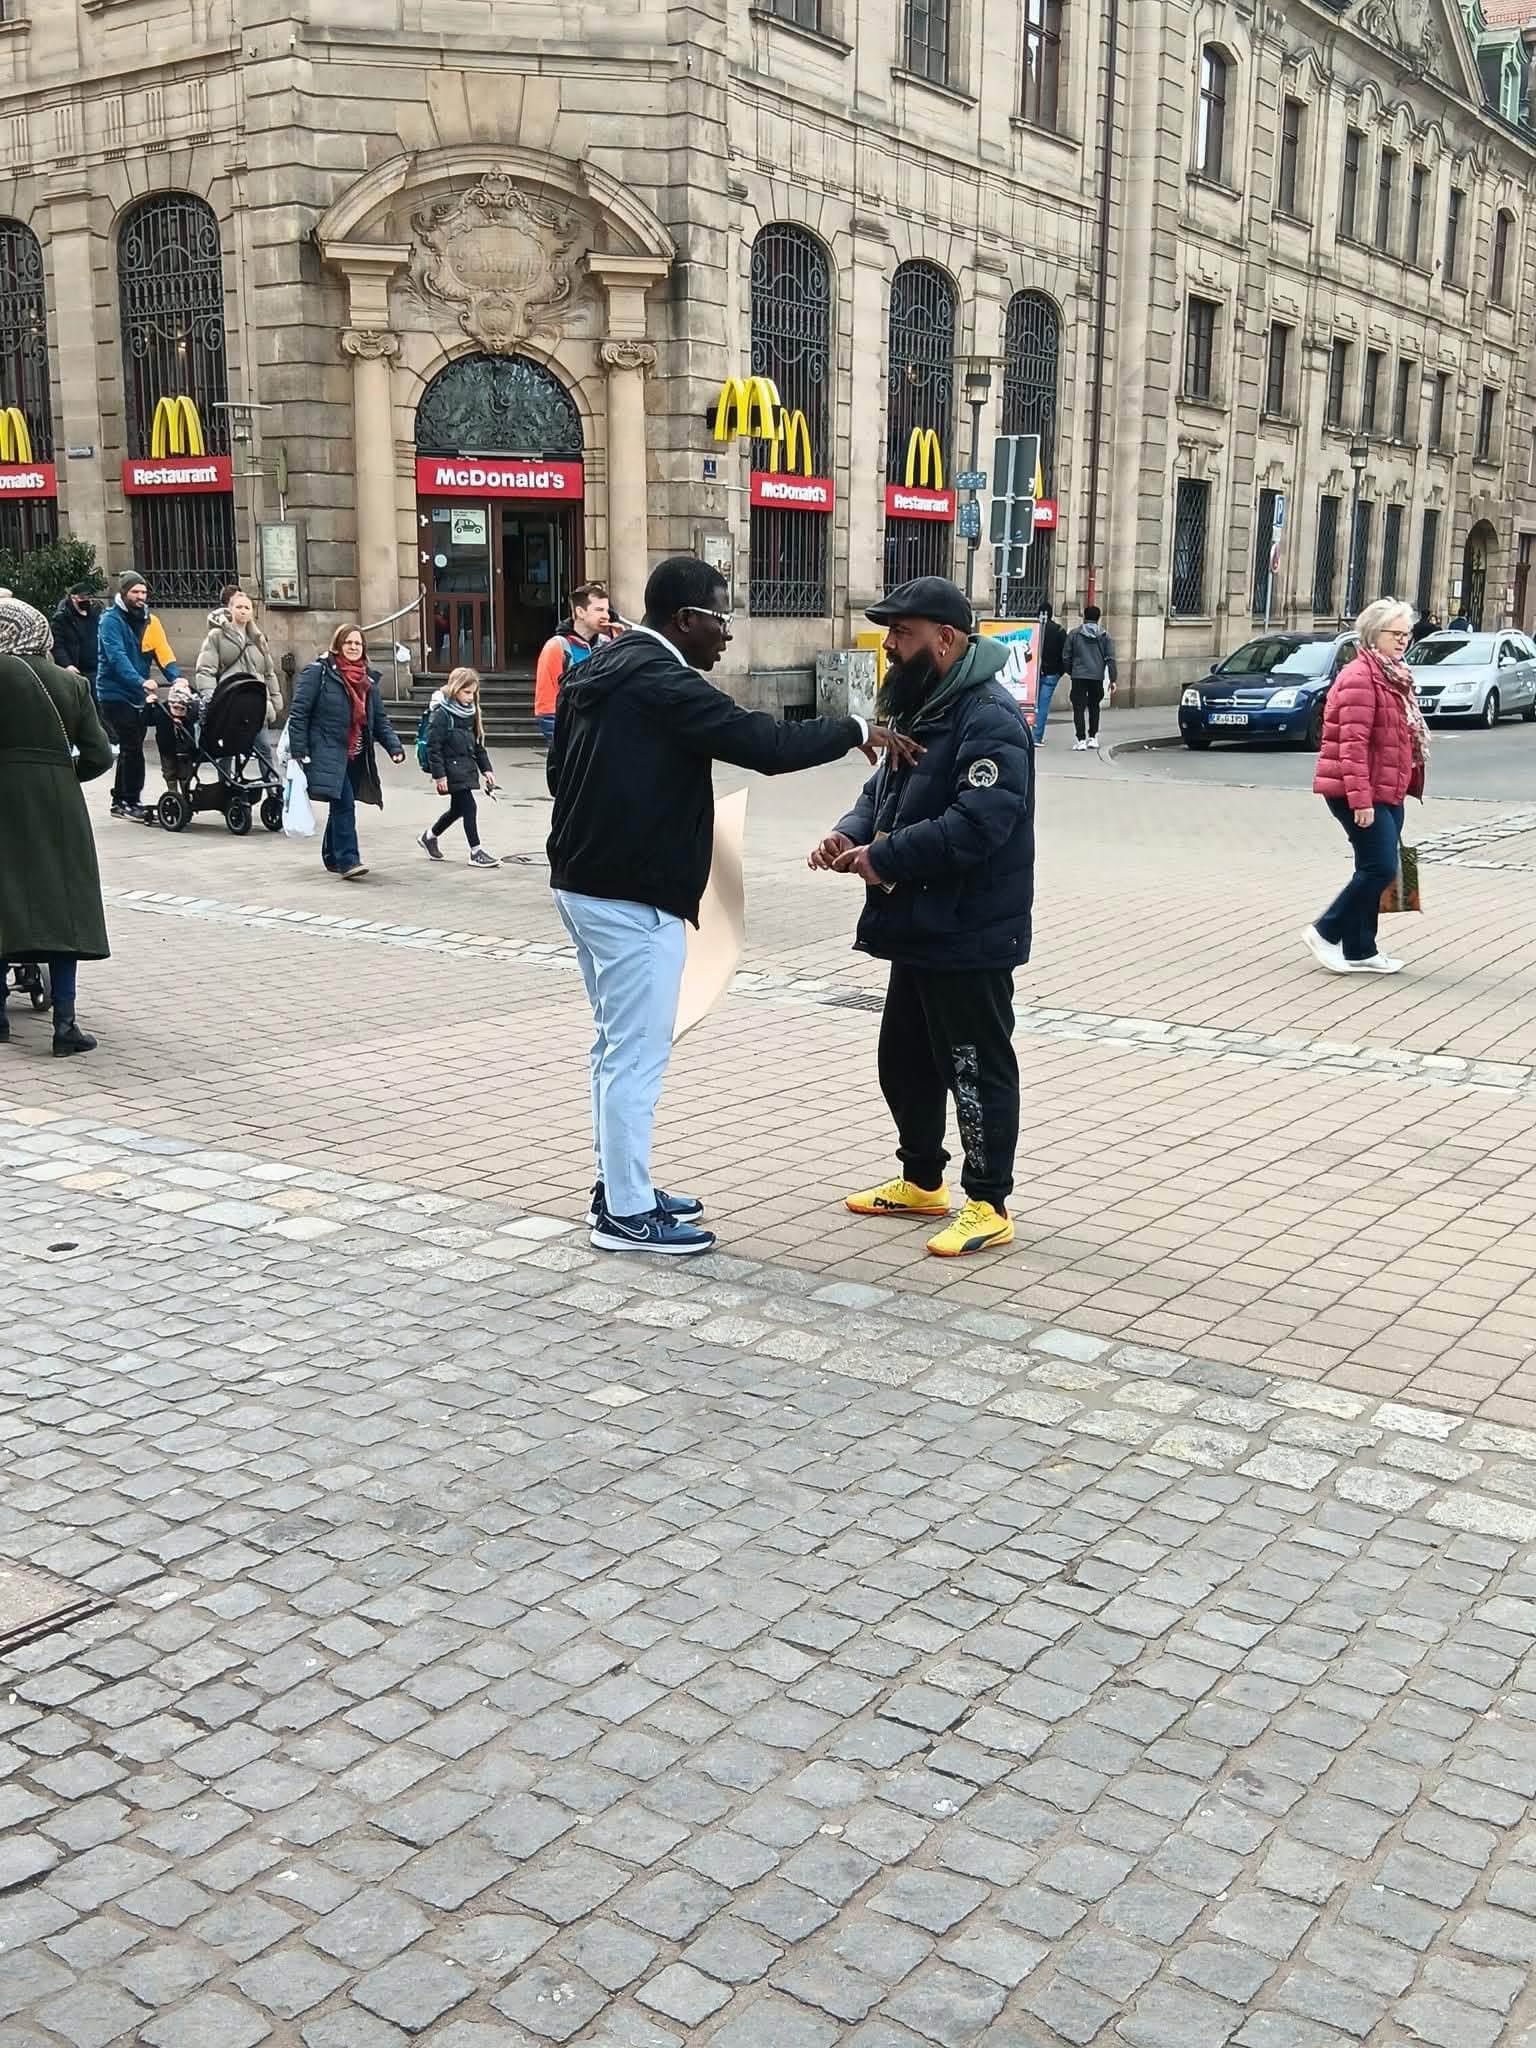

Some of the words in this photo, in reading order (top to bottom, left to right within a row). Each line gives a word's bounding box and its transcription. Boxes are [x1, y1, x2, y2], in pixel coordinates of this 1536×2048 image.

[0, 472, 46, 489] onald's
[133, 466, 218, 485] Restaurant
[435, 468, 565, 489] McDonald's
[761, 481, 827, 503] McDonald's
[894, 494, 949, 513] Restaurant
